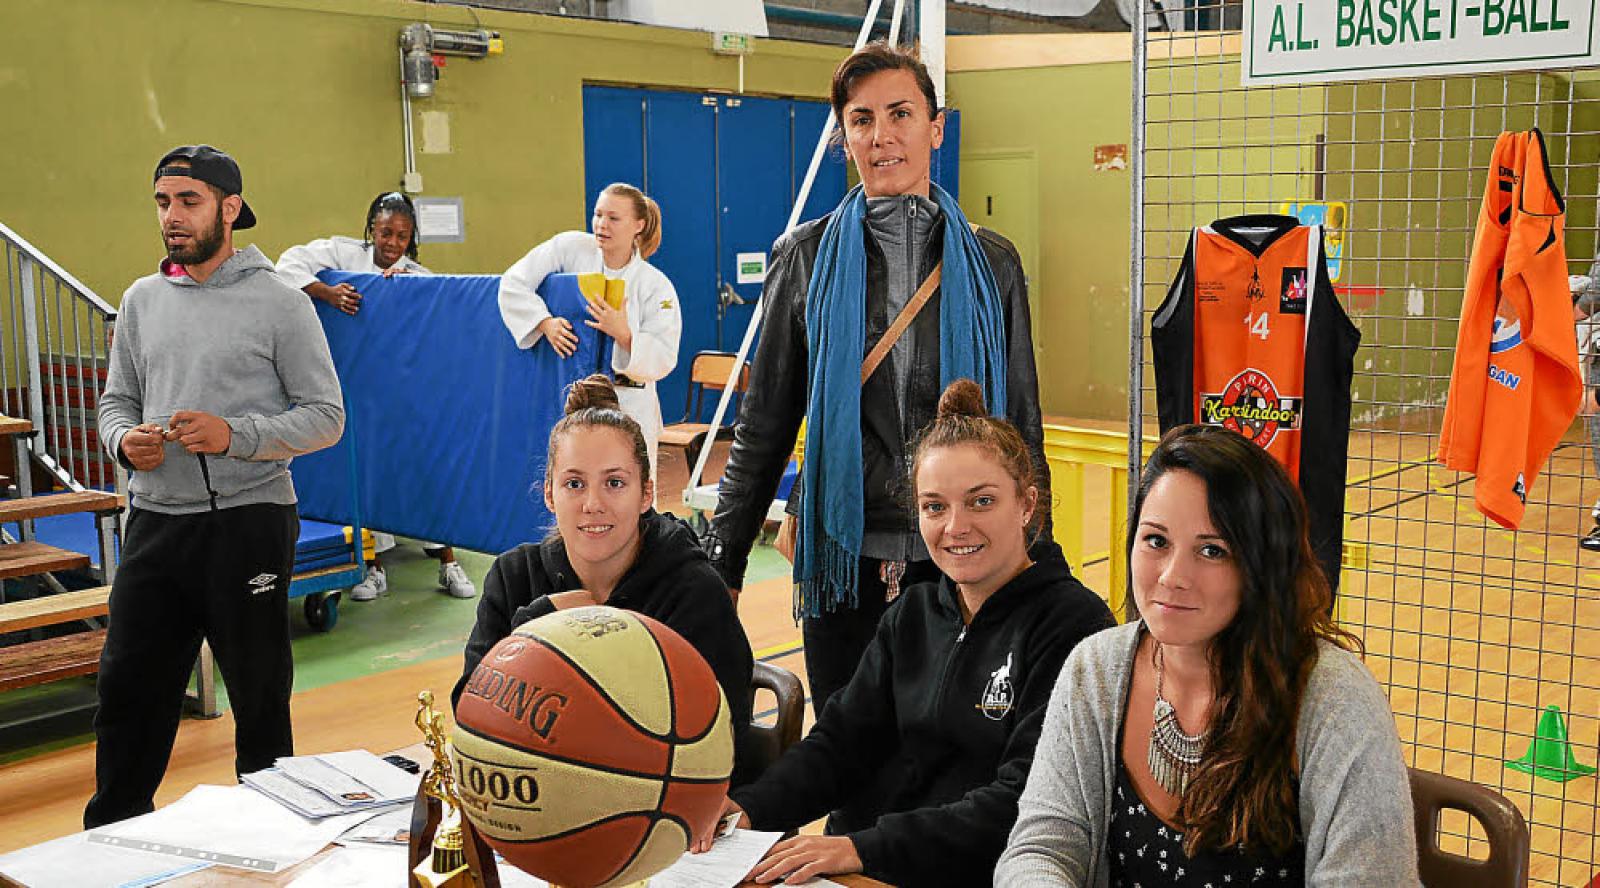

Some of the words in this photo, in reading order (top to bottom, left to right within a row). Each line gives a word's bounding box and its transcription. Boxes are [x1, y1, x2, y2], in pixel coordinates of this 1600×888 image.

[1268, 3, 1319, 52] A.L.
[1336, 0, 1570, 48] BASKET-BALL
[1243, 311, 1269, 340] 14
[457, 758, 539, 804] 1000
